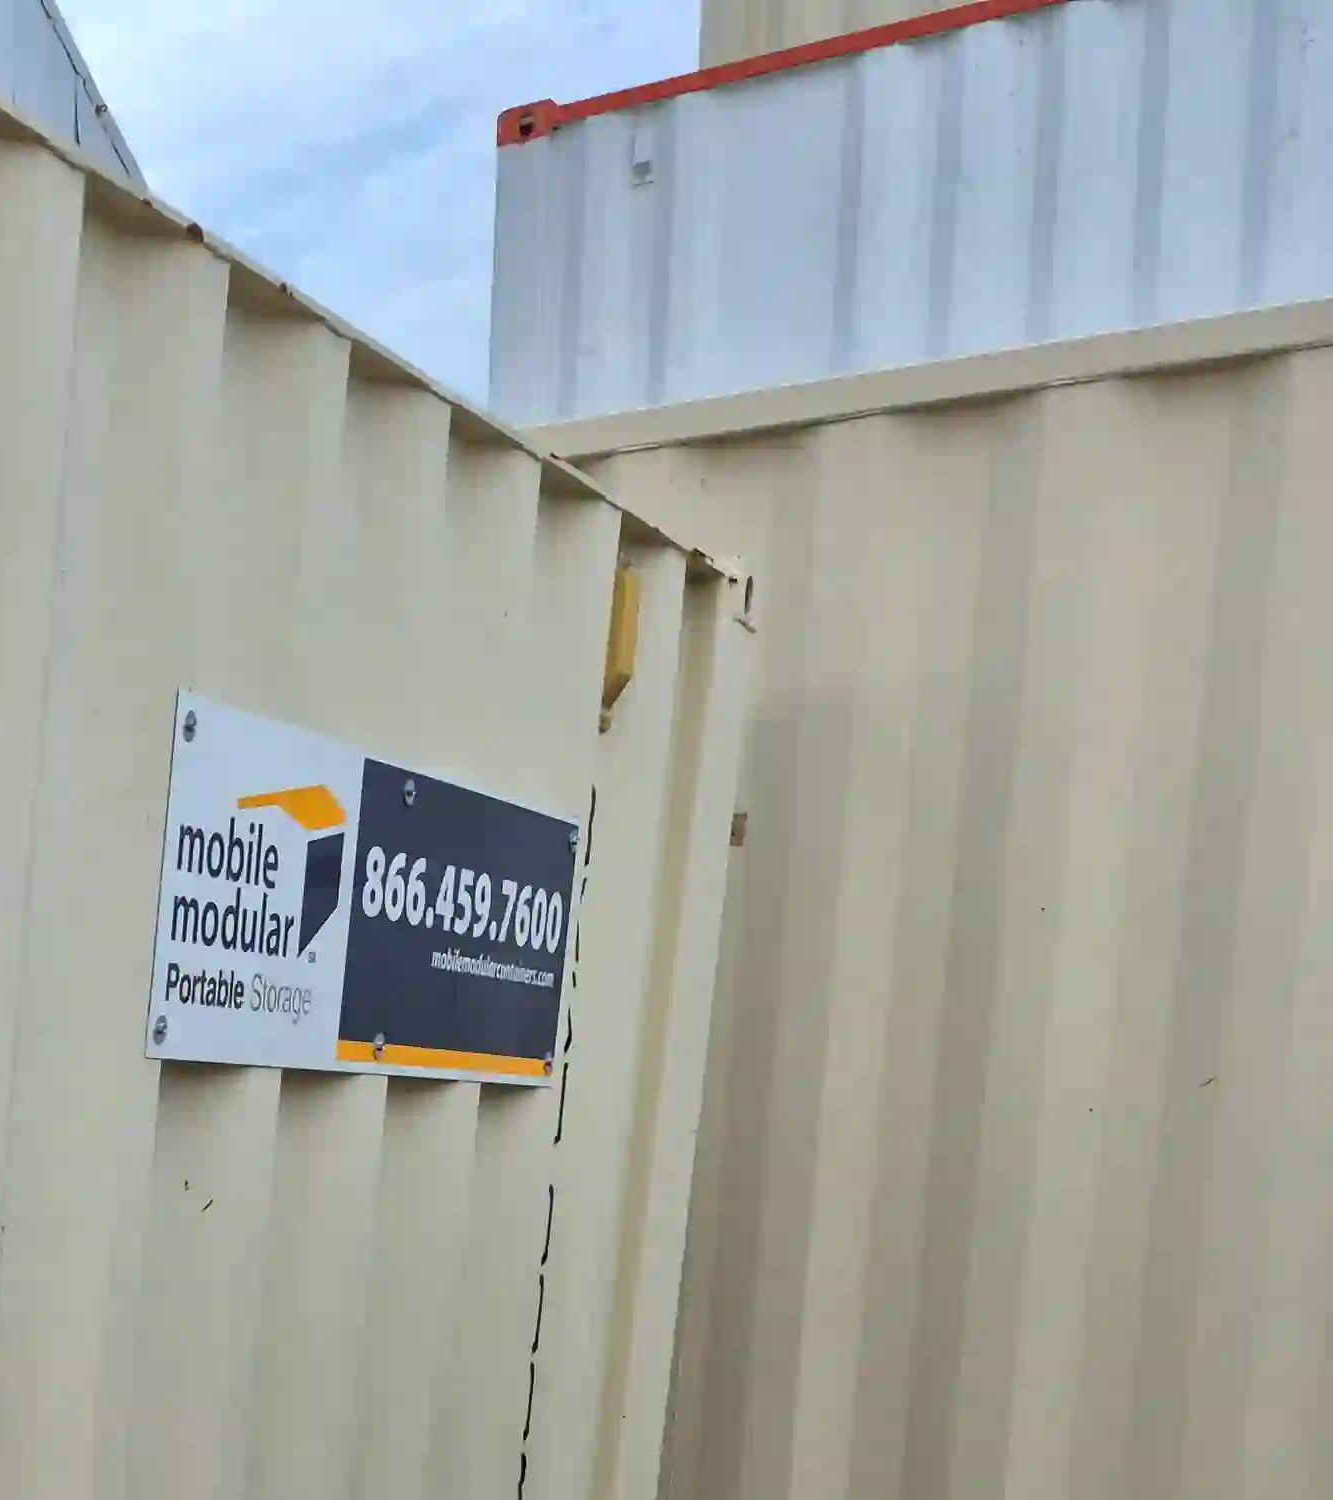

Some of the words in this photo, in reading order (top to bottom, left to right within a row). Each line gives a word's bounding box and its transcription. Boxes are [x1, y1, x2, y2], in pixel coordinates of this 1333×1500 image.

[176, 816, 279, 889] mobile
[170, 886, 295, 958] modular
[361, 845, 564, 955] 866.459.7600
[164, 961, 245, 1010] Portable
[249, 972, 312, 1026] Storage
